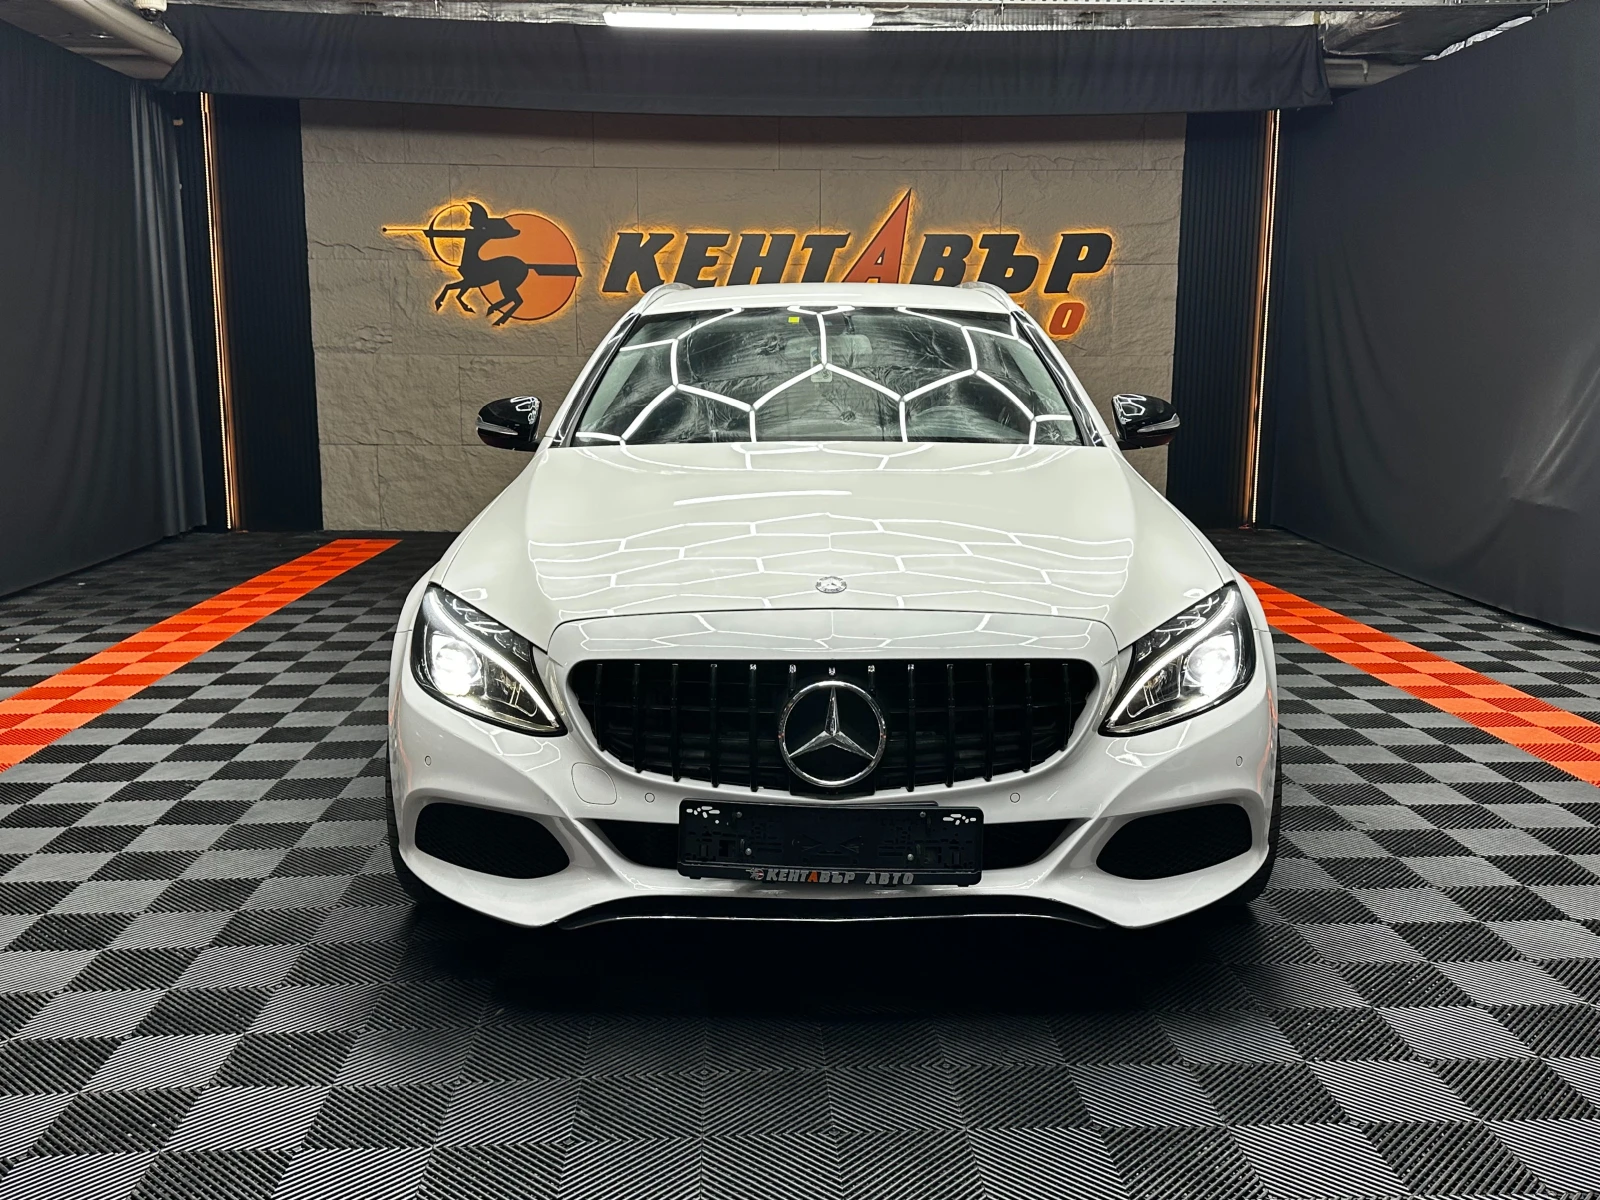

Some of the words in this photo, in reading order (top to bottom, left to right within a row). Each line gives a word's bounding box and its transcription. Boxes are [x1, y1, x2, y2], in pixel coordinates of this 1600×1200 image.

[601, 187, 1113, 293] КЕНТАВЪР
[766, 868, 856, 884] КЕНТАВЪР
[865, 872, 915, 885] АВТО
